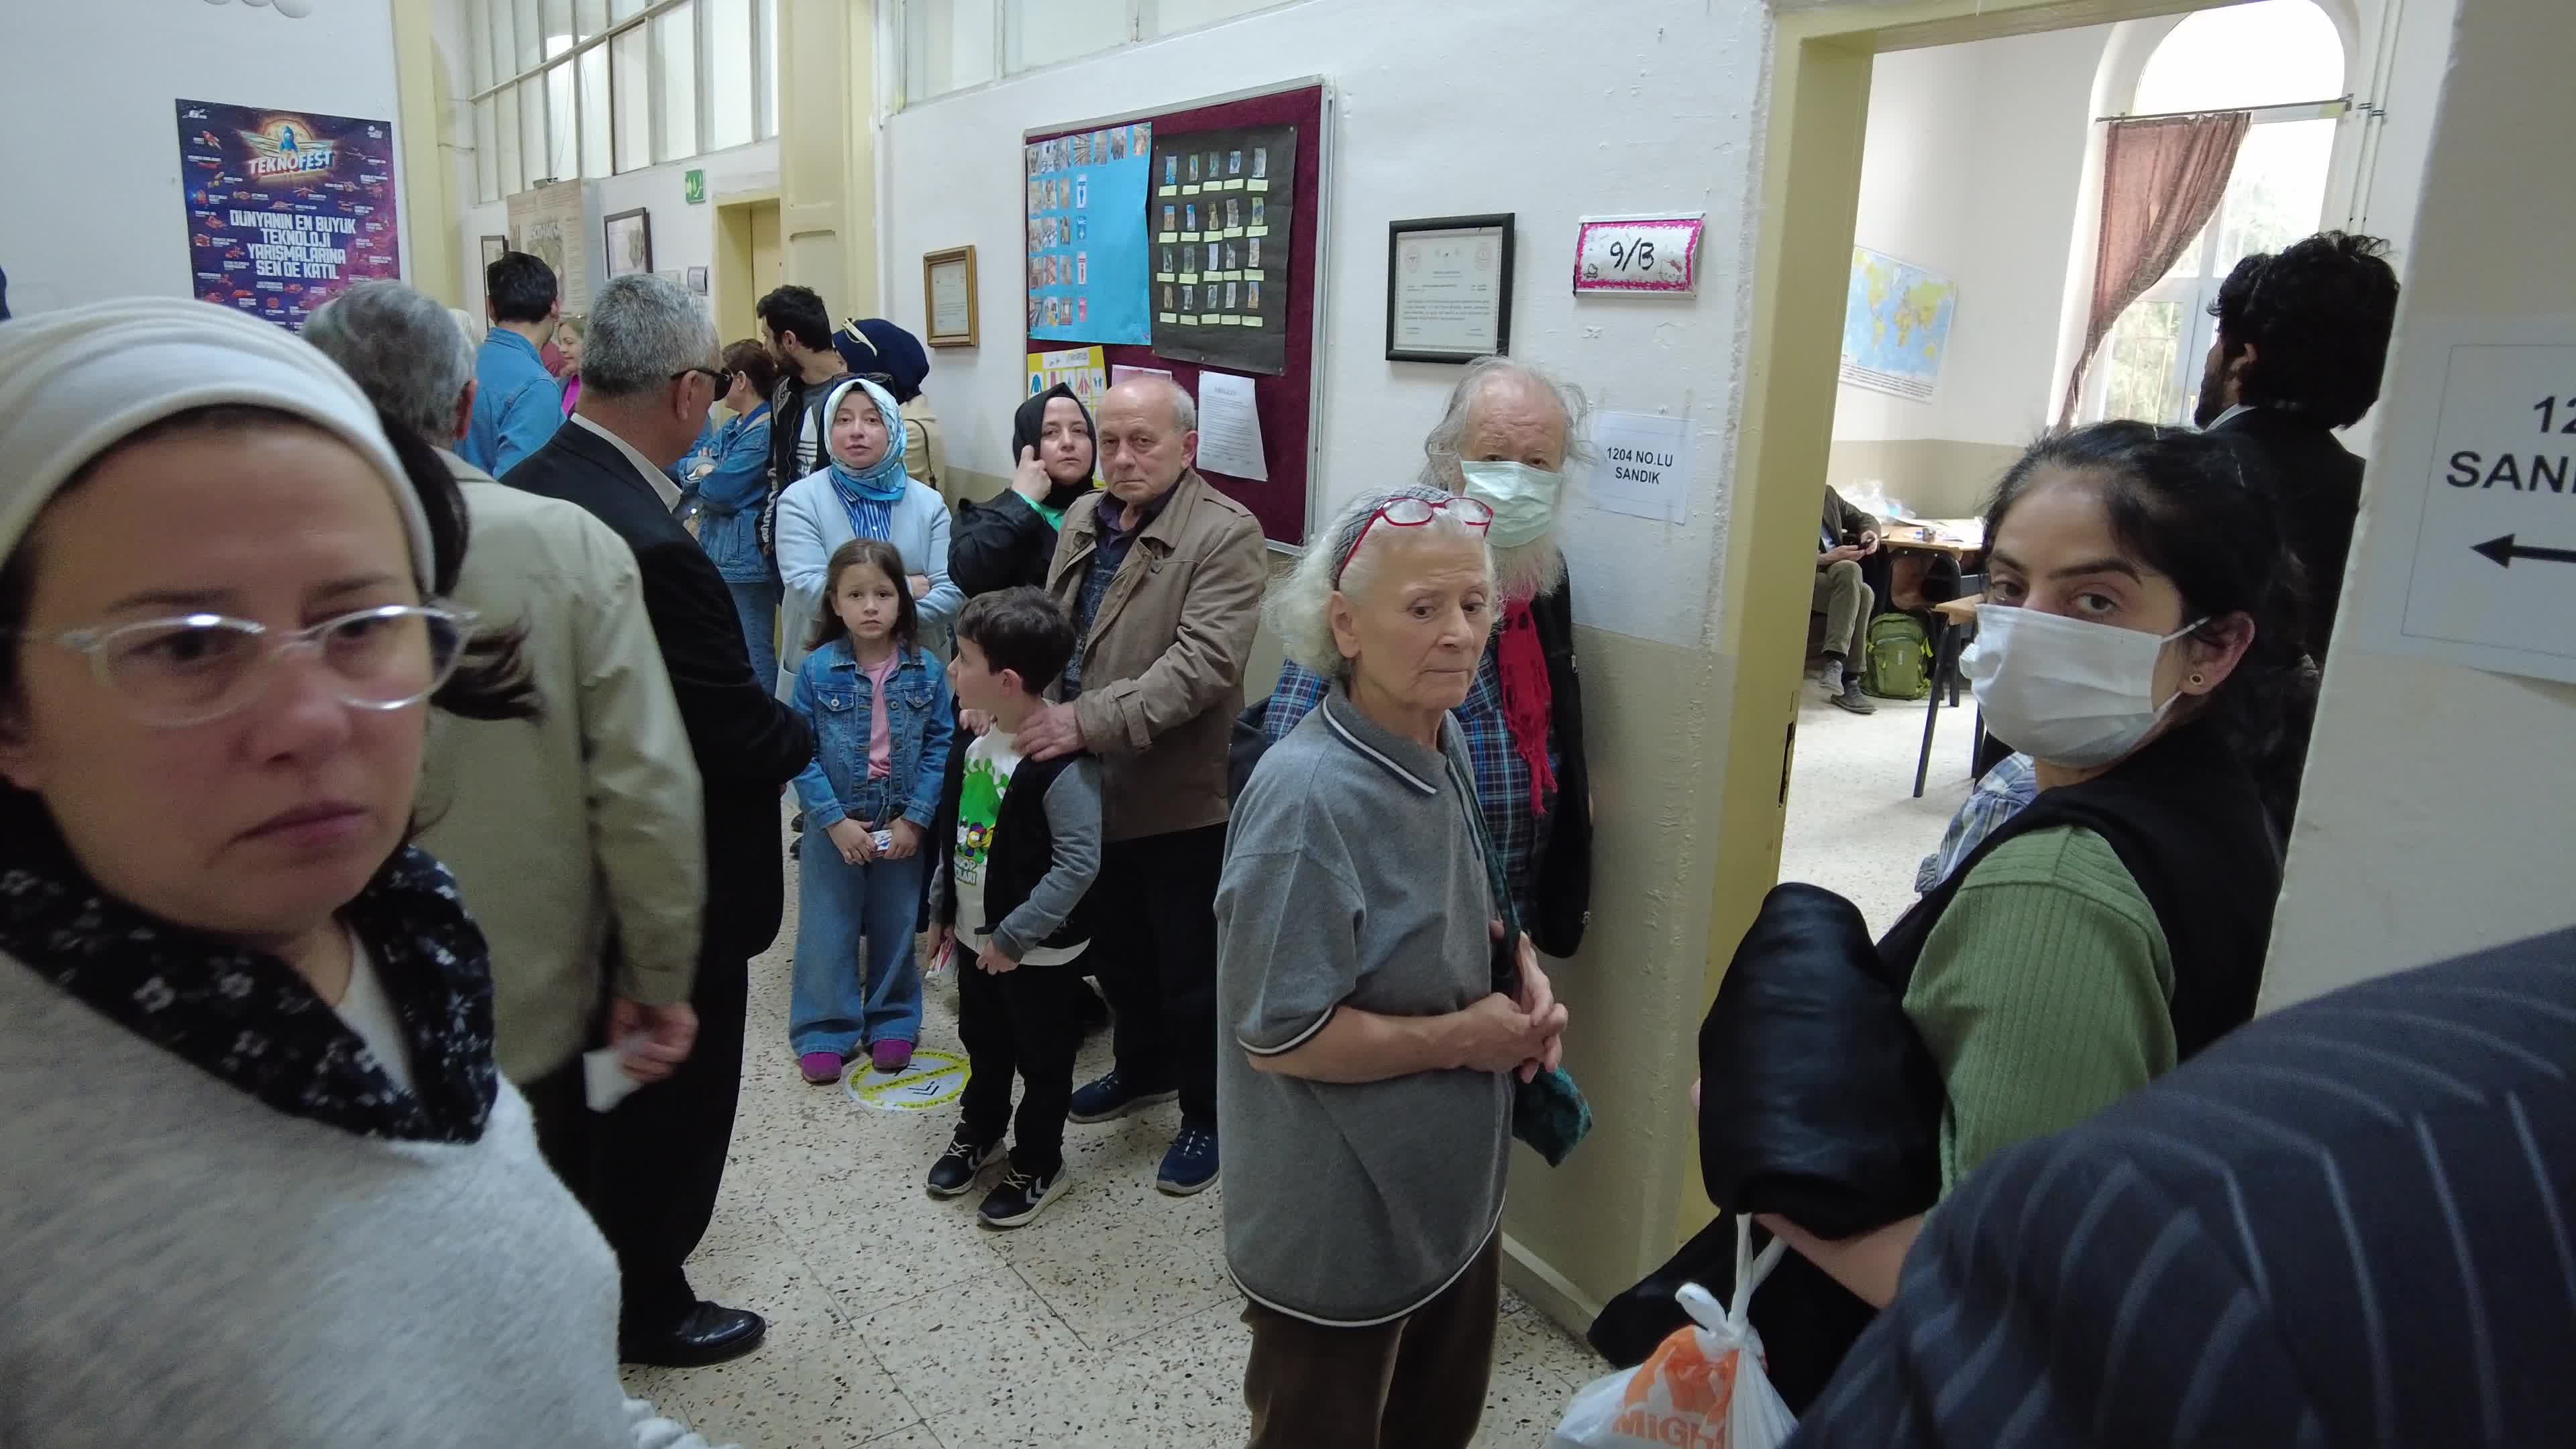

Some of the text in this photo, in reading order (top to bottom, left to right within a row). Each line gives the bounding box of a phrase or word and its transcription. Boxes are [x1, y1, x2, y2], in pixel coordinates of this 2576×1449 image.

[248, 149, 333, 175] TEKNOFEST
[295, 215, 313, 231] EN
[1609, 236, 1656, 272] 9/B
[256, 260, 282, 276] SEN
[283, 261, 301, 277] DE
[303, 263, 340, 280] KATIL
[1607, 447, 1674, 468] 1204 NO.LU
[1615, 466, 1662, 485] SANDIK
[2446, 450, 2576, 494] SAN
